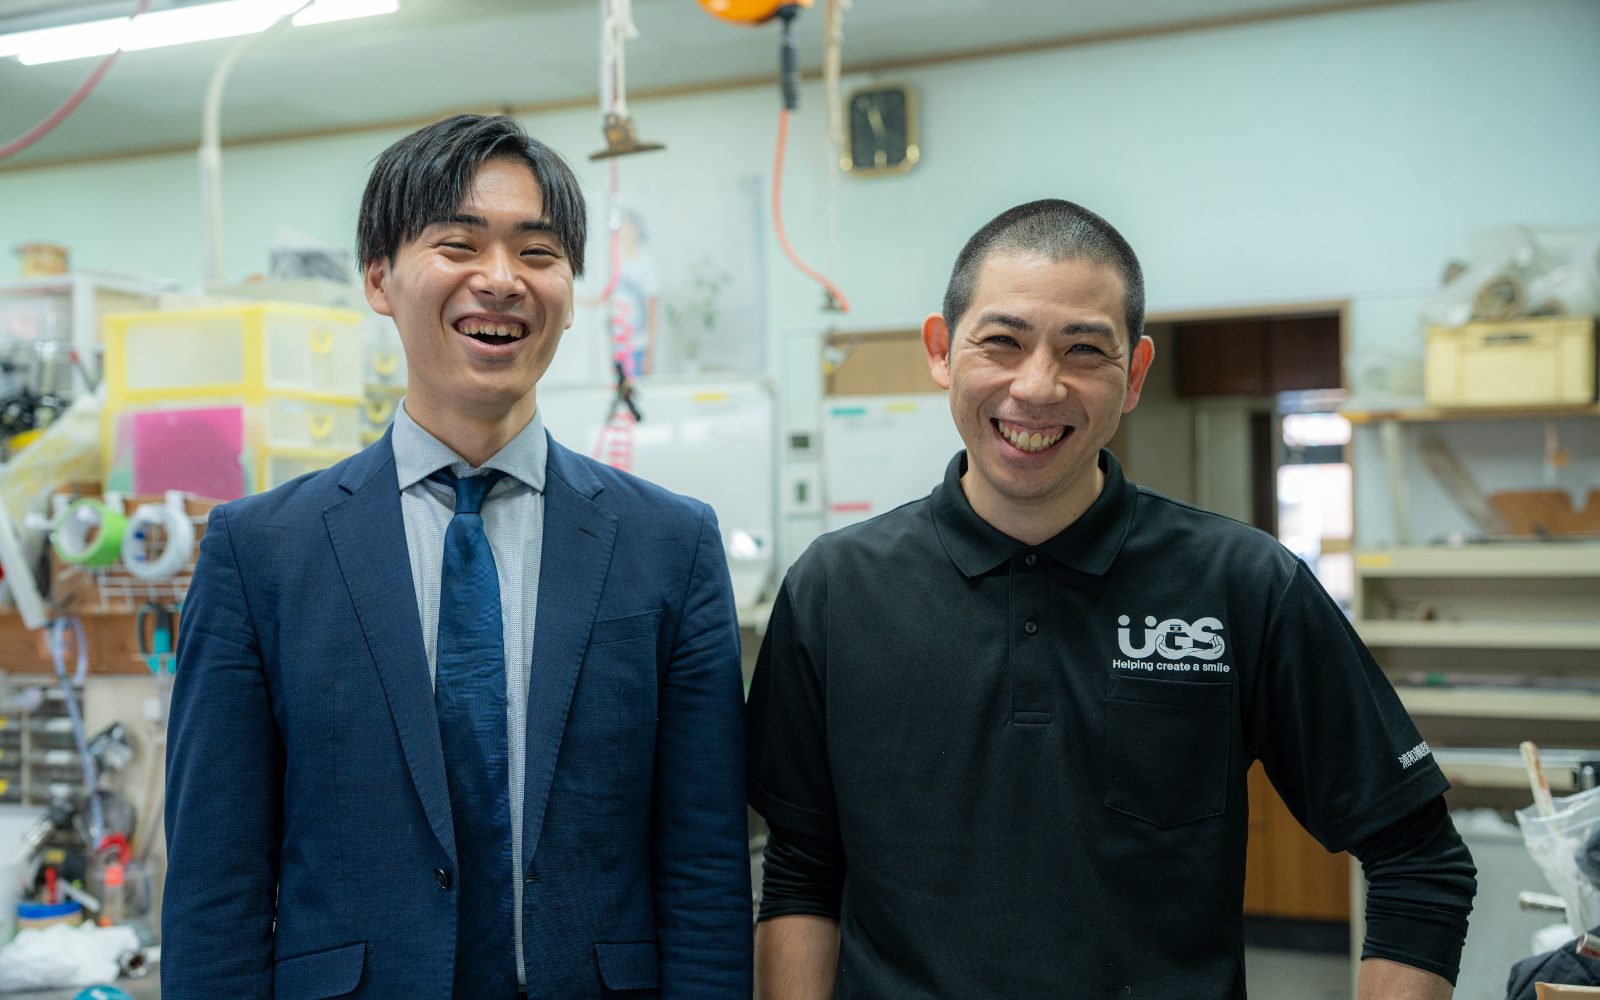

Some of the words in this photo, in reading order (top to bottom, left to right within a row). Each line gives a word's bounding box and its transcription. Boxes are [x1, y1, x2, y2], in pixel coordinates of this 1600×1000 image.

[1112, 659, 1153, 671] Helping
[1156, 661, 1191, 671] create
[1192, 662, 1200, 671] a
[1202, 662, 1230, 673] smile
